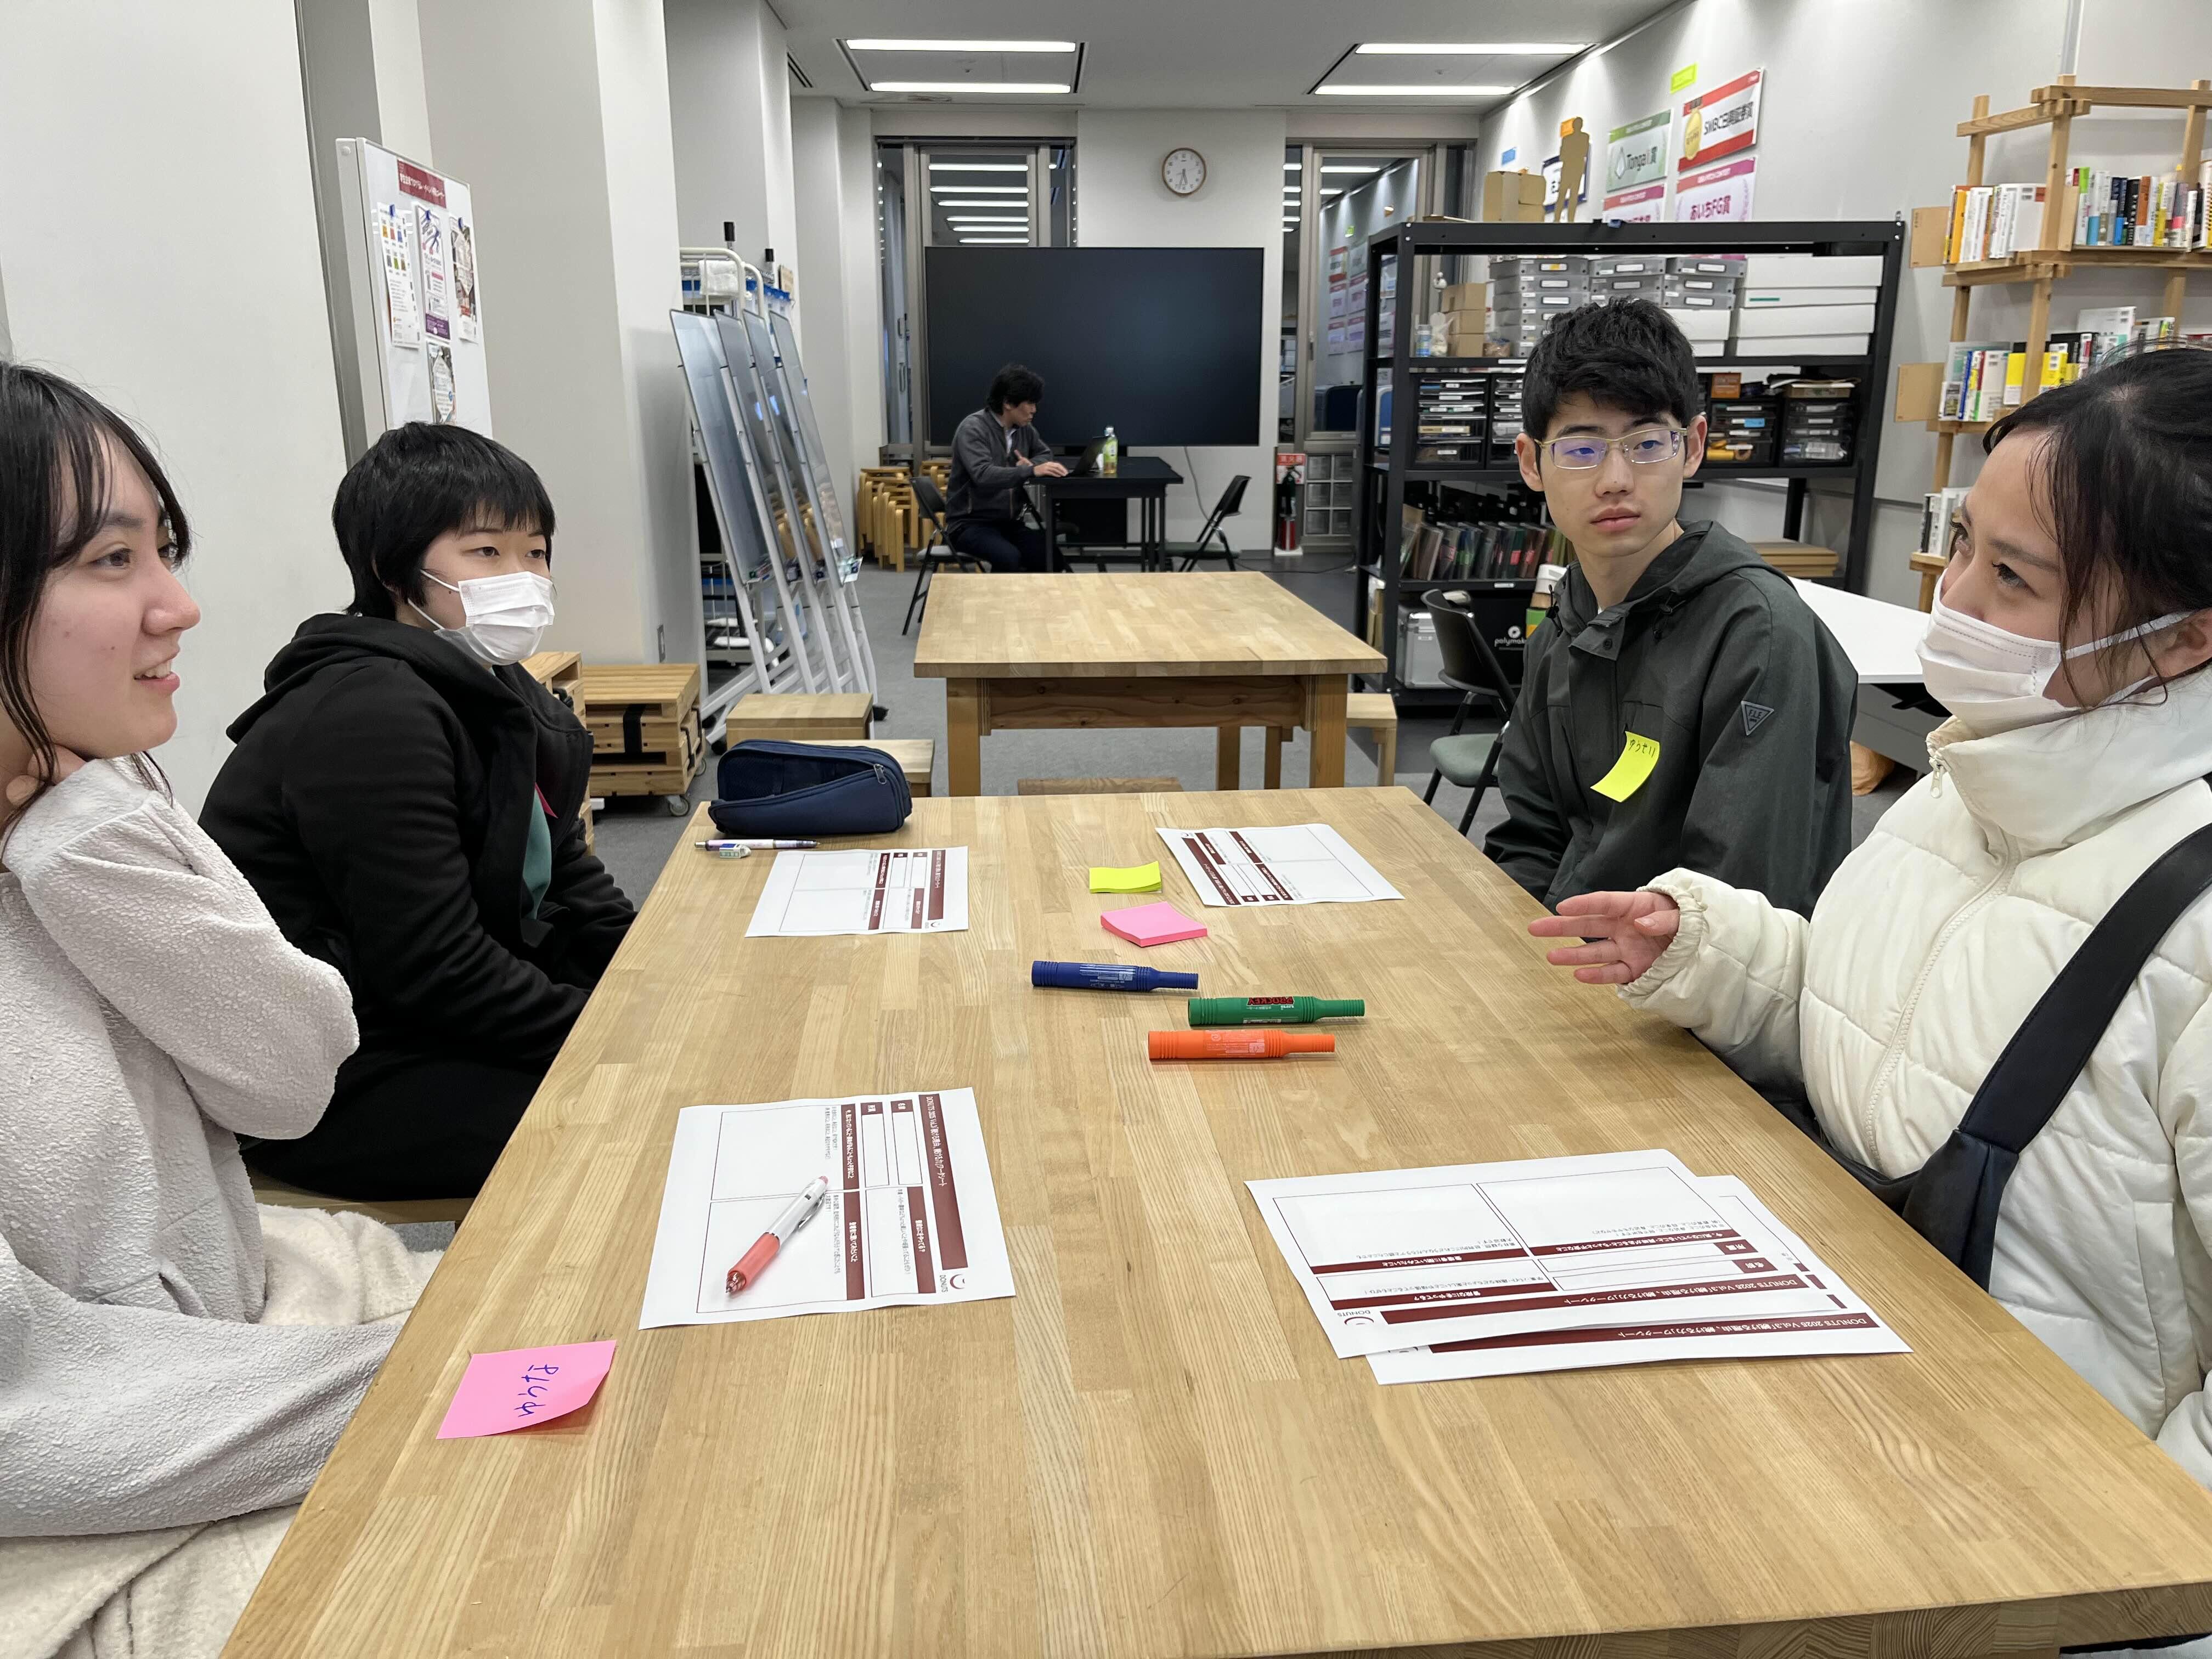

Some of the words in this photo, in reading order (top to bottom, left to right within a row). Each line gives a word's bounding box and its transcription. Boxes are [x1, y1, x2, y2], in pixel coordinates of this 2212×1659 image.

[1494, 637, 1527, 647] polymak
[925, 1096, 935, 1110] DONUTS
[939, 1274, 947, 1293] DONUTS
[1755, 1279, 1799, 1288] DONUTS
